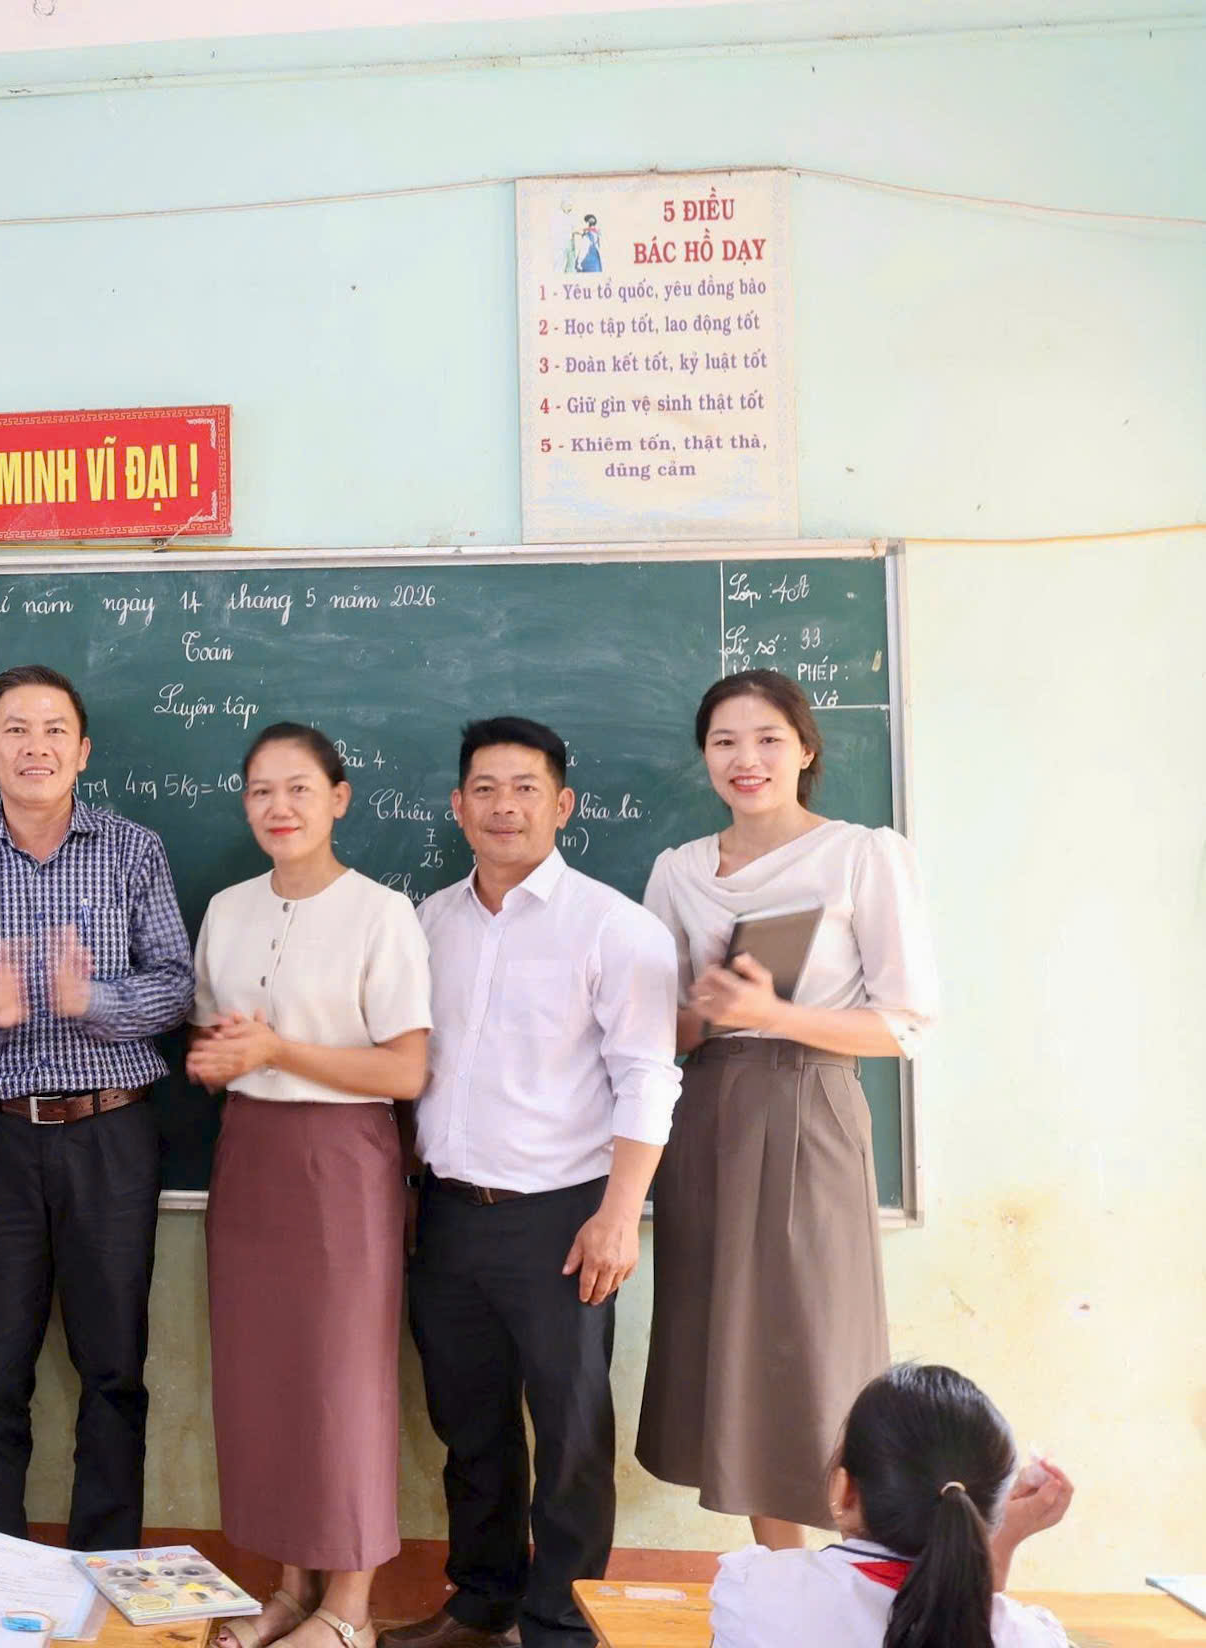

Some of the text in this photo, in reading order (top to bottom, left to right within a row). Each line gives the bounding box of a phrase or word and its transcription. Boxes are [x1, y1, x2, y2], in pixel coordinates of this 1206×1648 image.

[664, 187, 735, 222] 5 ĐIỀU
[633, 228, 766, 266] BÁC HỒ DẠY
[539, 286, 546, 300] 1
[563, 282, 591, 300] Yêu
[597, 277, 612, 299] tổ
[618, 279, 658, 303] quốc,
[664, 280, 692, 301] yêu
[697, 274, 734, 300] đồng
[538, 309, 759, 339] 2 Học tập tốt, lao động tốt
[538, 357, 549, 373] 3
[566, 355, 605, 373] Đoàn
[612, 352, 638, 372] kết
[645, 351, 673, 371] tốt,
[706, 353, 737, 370] luật
[743, 348, 767, 369] tốt
[540, 390, 764, 417] 4 Giữ gìn vệ sinh thật tốt
[541, 439, 551, 453] 5
[571, 436, 632, 453] Khiêm
[640, 433, 676, 452] tốn,
[684, 434, 722, 453] thật
[87, 436, 117, 501] VĨ
[126, 443, 179, 512] ĐẠI
[190, 443, 200, 497] !
[605, 459, 696, 481] dũng cảm
[24, 588, 73, 615] năm
[103, 586, 155, 626] ngày
[179, 592, 203, 615] 14
[228, 584, 293, 627] tháng
[306, 587, 316, 609] 5
[329, 584, 379, 609] năm
[390, 585, 436, 608] 2026
[728, 573, 761, 608] Lớp
[182, 631, 233, 663] Toán
[800, 627, 821, 650] 33
[154, 684, 259, 730] Luyện tập
[368, 788, 435, 821] Chiều
[426, 828, 436, 844] 7
[420, 849, 443, 868] 25
